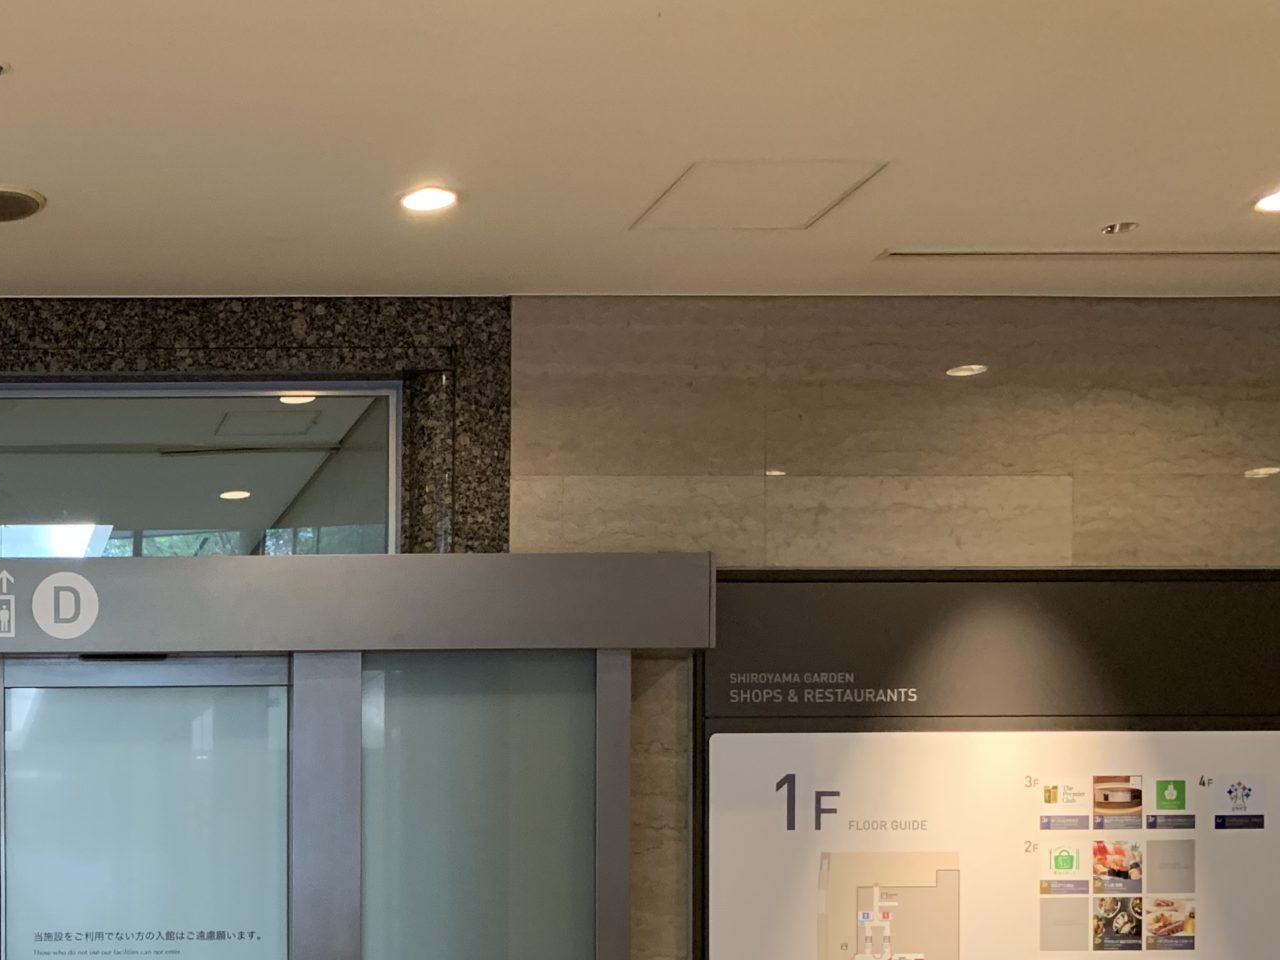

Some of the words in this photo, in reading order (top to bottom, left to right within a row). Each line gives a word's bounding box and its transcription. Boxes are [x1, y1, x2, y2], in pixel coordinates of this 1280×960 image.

[53, 586, 81, 625] D
[729, 672, 801, 684] SHIROYAMA
[803, 672, 855, 684] GARDEN
[729, 688, 783, 703] SHOPS
[787, 688, 799, 703] &
[803, 687, 918, 702] RESTAURANTS
[1024, 775, 1039, 788] 3F
[1198, 775, 1213, 787] 4F
[775, 773, 841, 831] 1F
[848, 819, 888, 831] FLOOR
[890, 819, 928, 831] GUIDE
[1024, 840, 1039, 853] 2F
